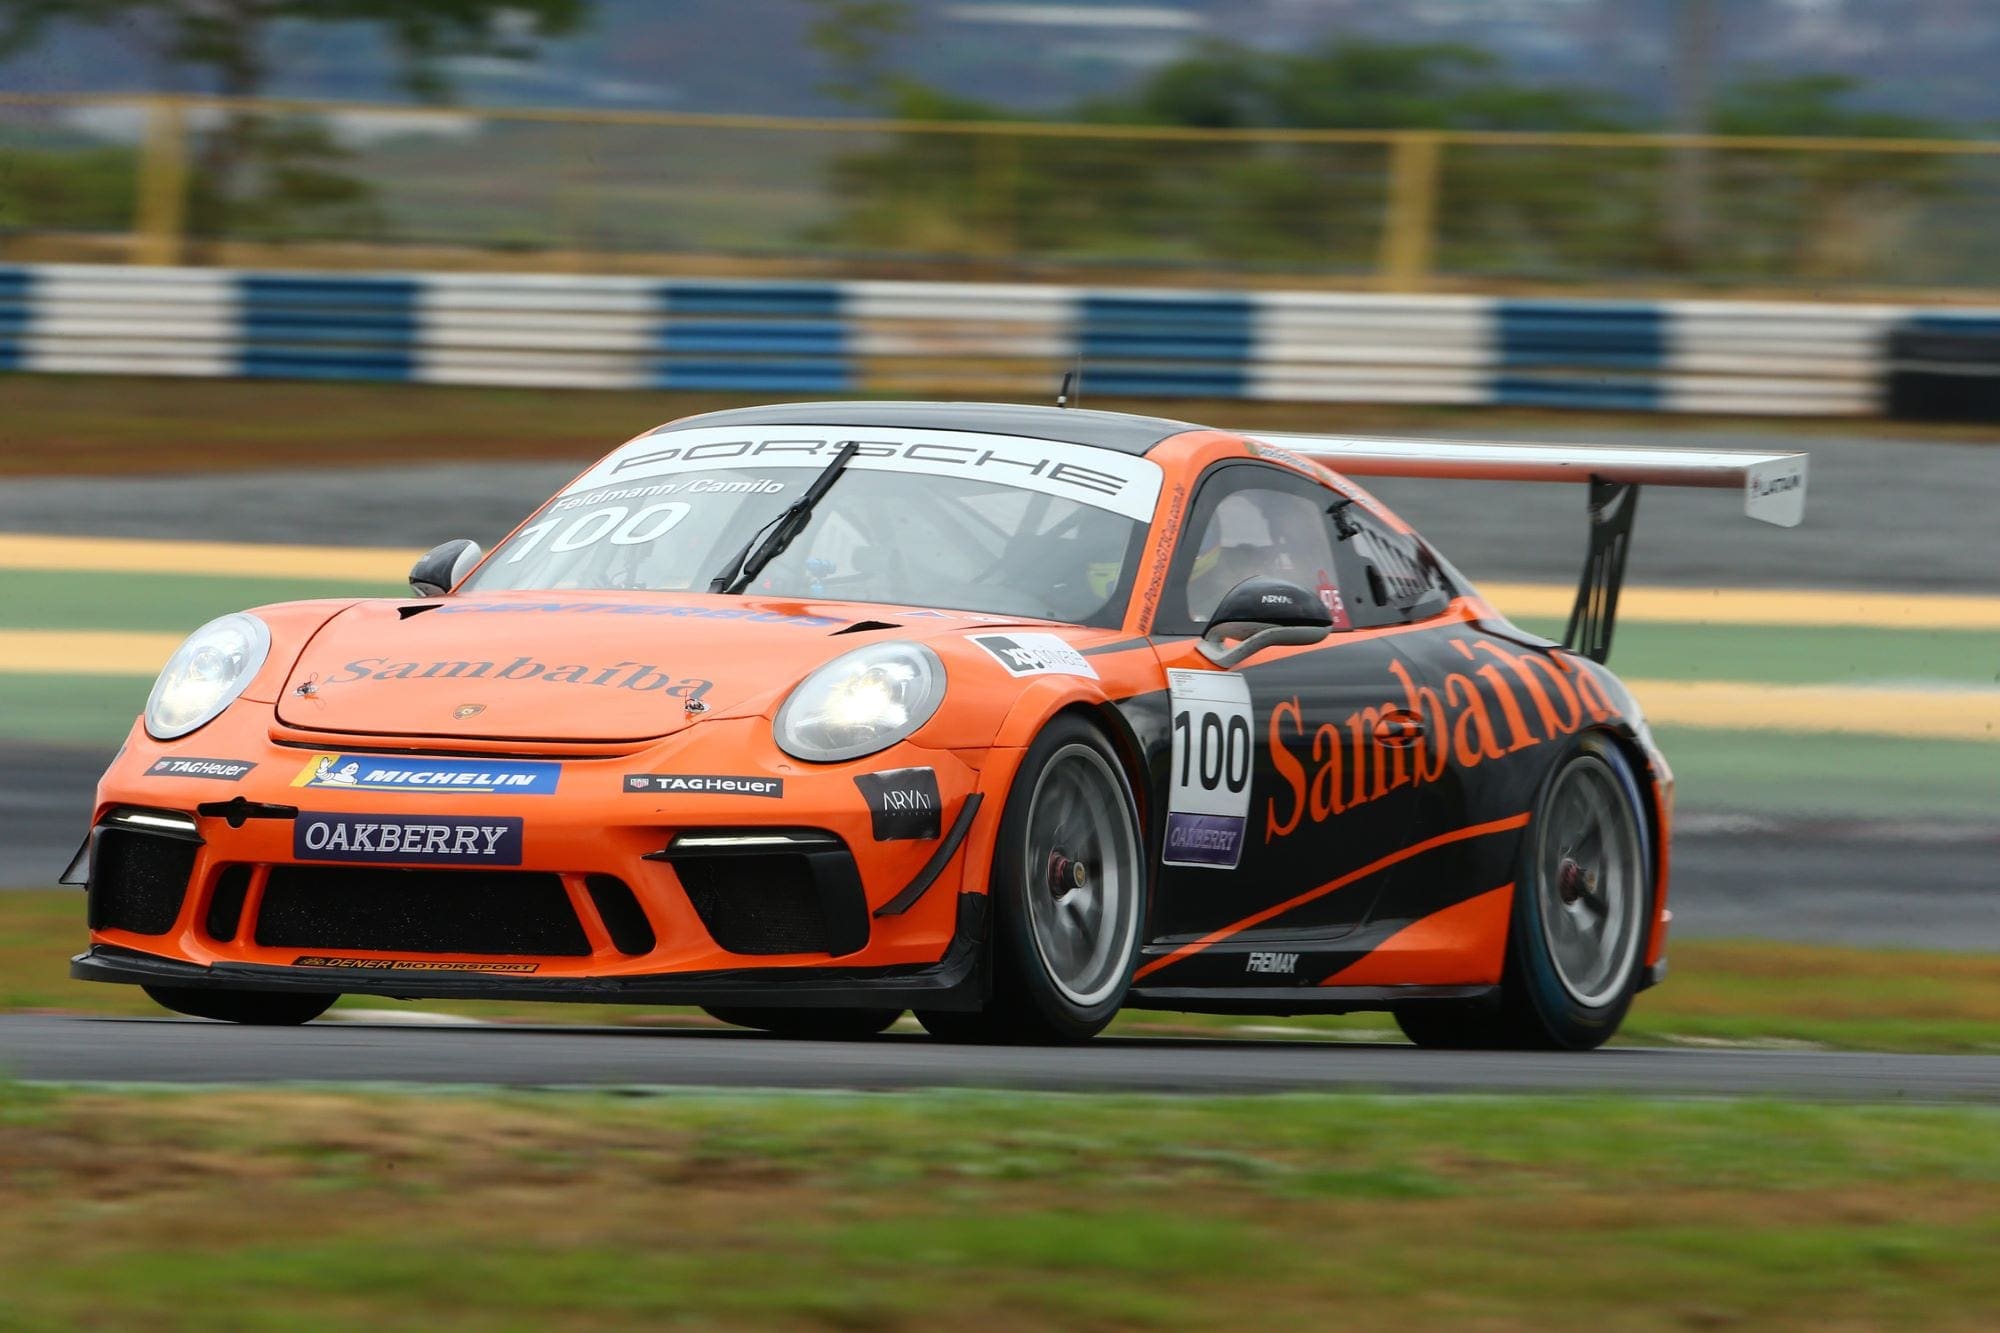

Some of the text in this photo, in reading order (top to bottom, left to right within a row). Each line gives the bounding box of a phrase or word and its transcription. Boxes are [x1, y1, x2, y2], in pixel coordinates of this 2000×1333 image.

[611, 439, 1128, 496] PORSCHE
[508, 502, 692, 565] 100
[1174, 710, 1250, 794] 100
[365, 768, 537, 787] MICHELIN
[304, 821, 509, 856] OAKBERRY
[1170, 826, 1238, 851] OAKBERRY
[326, 957, 533, 971] DENER MOTORSPORT
[1245, 952, 1300, 973] FREMAX
